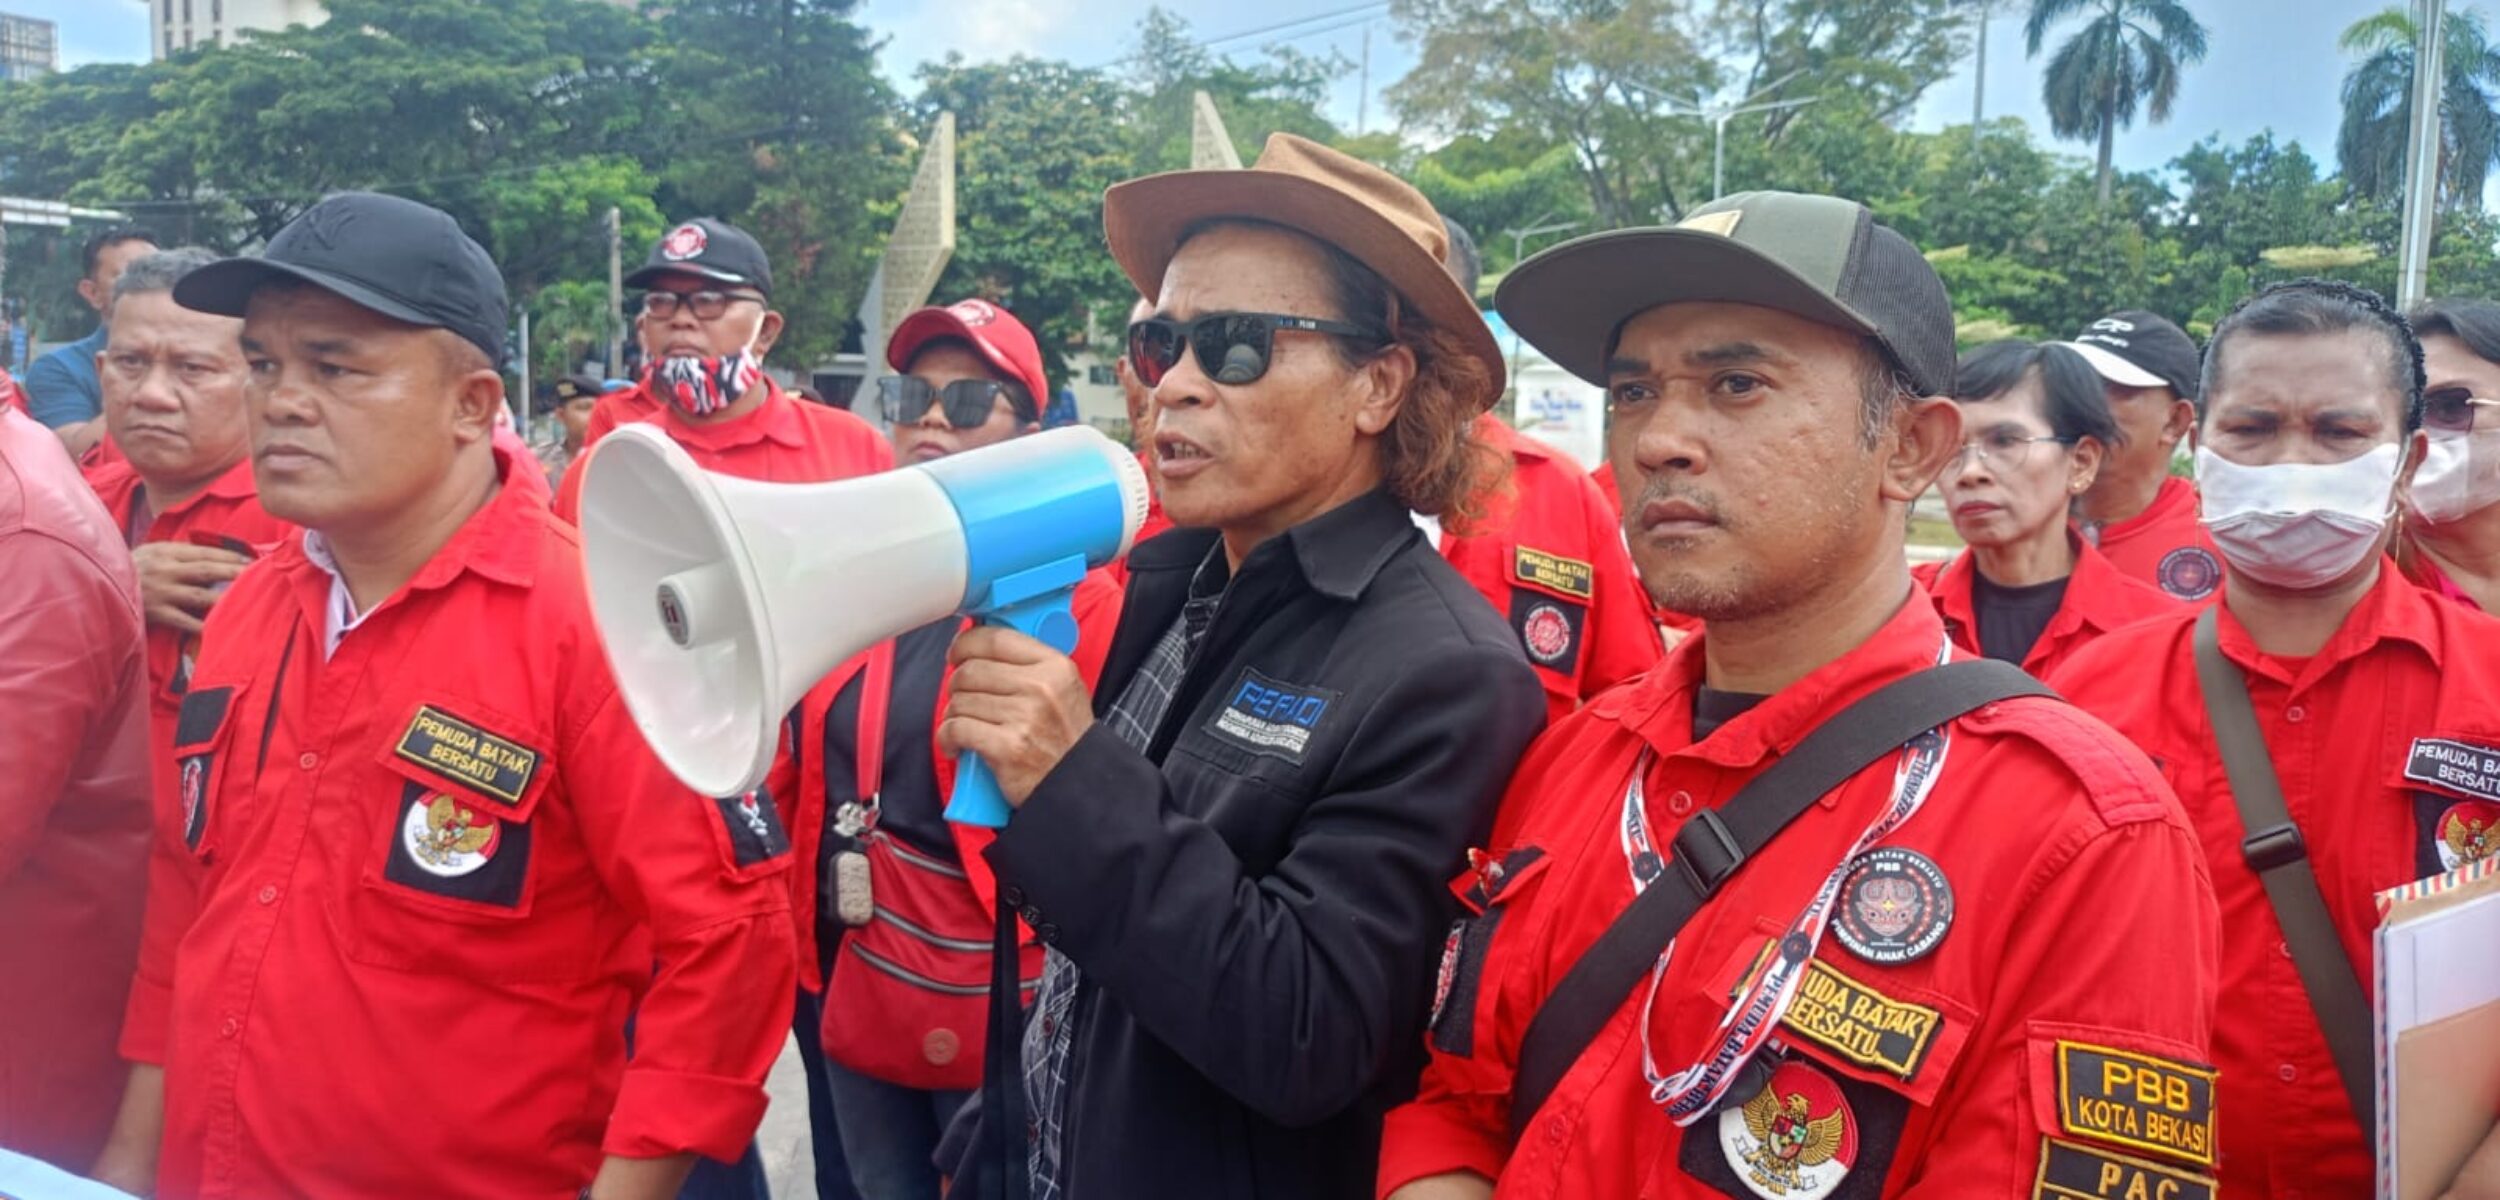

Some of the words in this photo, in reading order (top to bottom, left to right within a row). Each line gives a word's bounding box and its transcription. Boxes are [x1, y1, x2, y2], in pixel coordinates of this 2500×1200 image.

[416, 716, 477, 753] PEMUDA
[478, 742, 528, 775] BATAK
[429, 742, 497, 782] BERSATU
[2415, 745, 2478, 771] PEMUDA
[1876, 862, 1901, 872] PBB
[1875, 950, 1907, 961] ANAK
[1906, 921, 1946, 957] CABANG
[1736, 973, 1786, 1036] PEMUDA
[1850, 994, 1926, 1039] BATAK
[2103, 1060, 2192, 1112] PBB
[2078, 1096, 2139, 1136] KOTA
[2146, 1111, 2206, 1154] BEKASI
[2098, 1161, 2180, 1200] PAC
